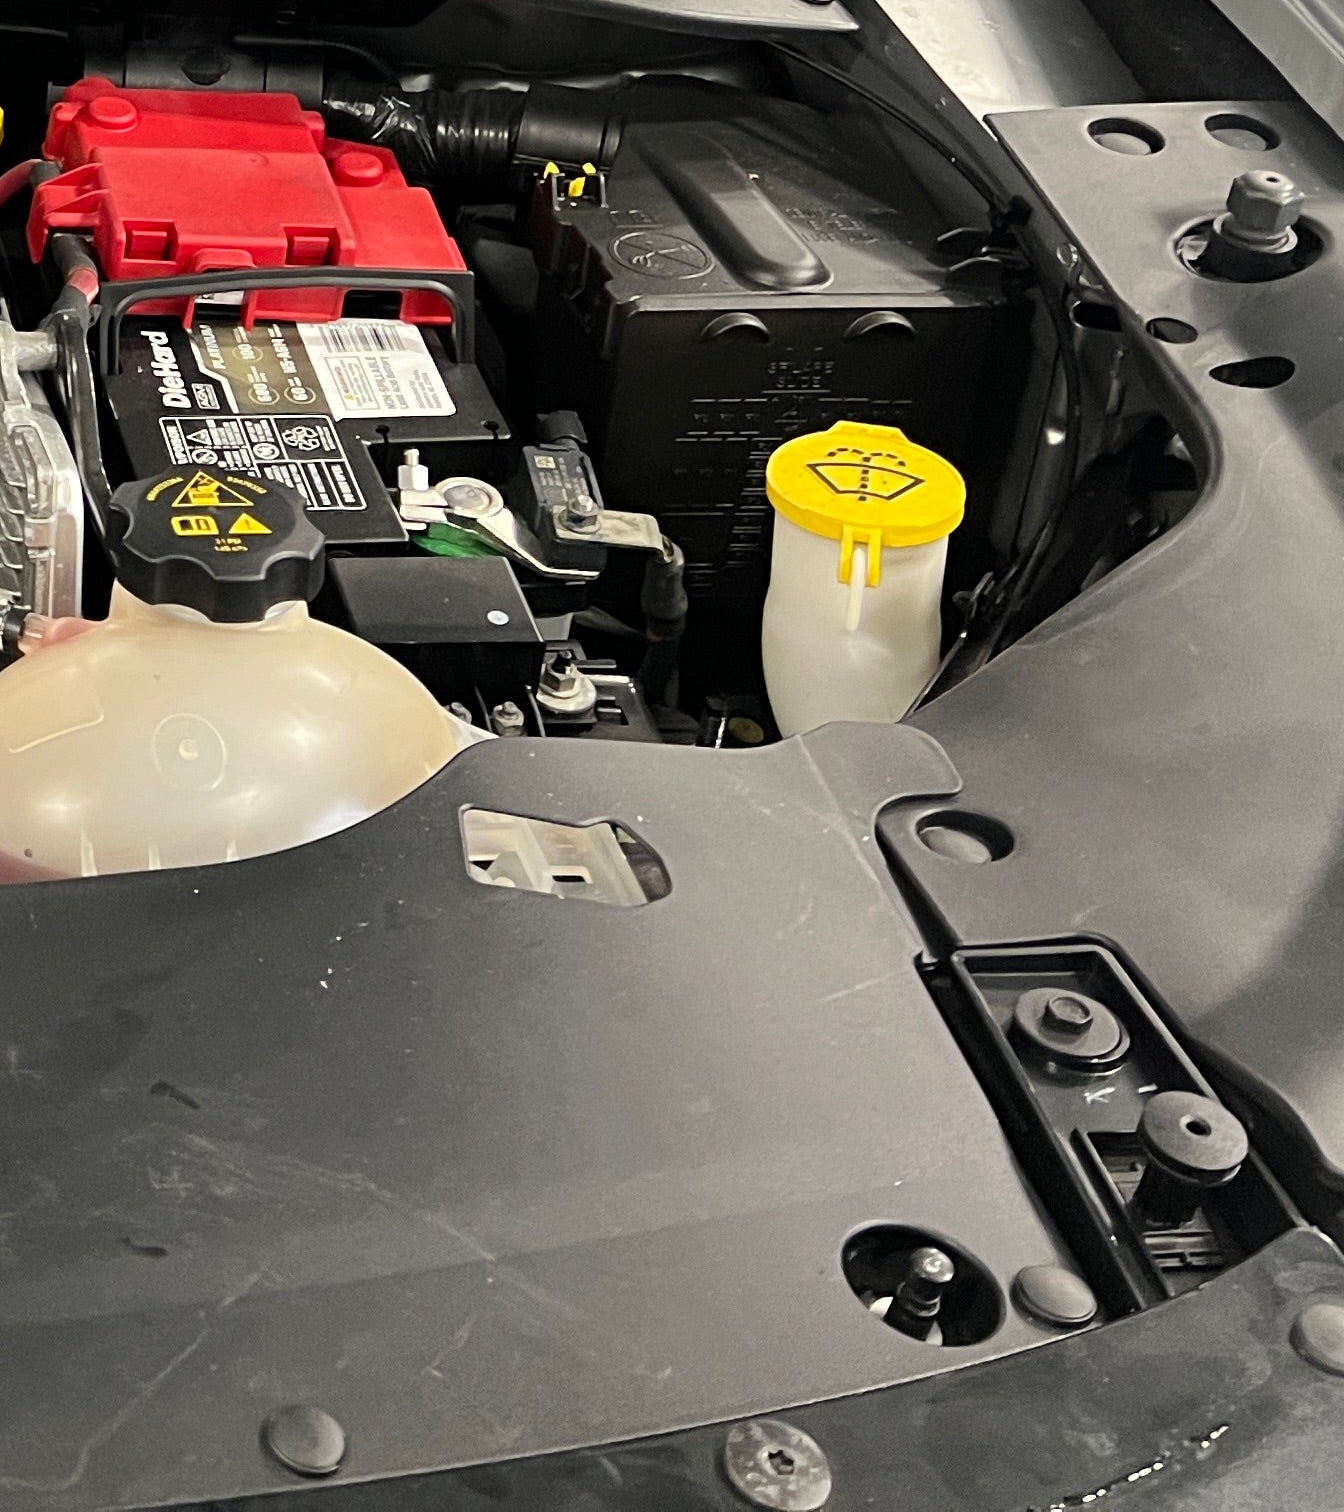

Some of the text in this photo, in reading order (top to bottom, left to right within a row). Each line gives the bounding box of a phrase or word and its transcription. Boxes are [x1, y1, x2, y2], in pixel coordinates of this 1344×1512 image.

[140, 330, 192, 409] DieHard
[199, 325, 226, 369] PLATINUM
[364, 356, 397, 409] NON-SPILLABLE
